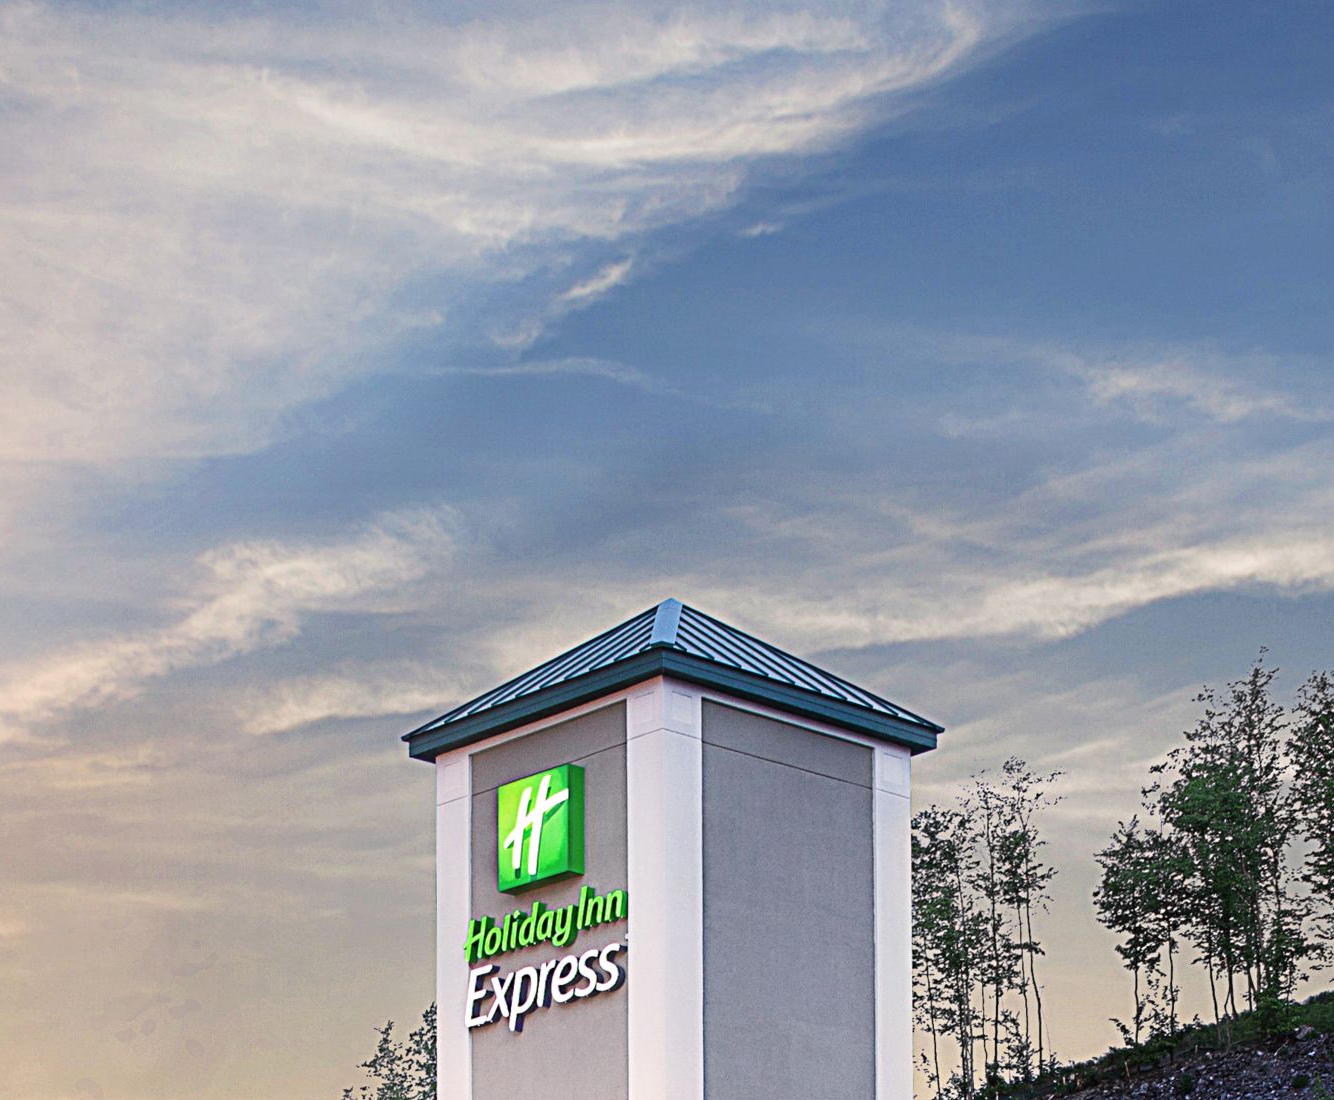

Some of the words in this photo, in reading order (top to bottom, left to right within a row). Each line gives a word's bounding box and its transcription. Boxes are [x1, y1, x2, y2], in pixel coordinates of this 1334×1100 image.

[503, 774, 569, 876] H
[464, 901, 575, 962] Holiday
[576, 885, 626, 931] Inn
[465, 943, 624, 1032] Express
